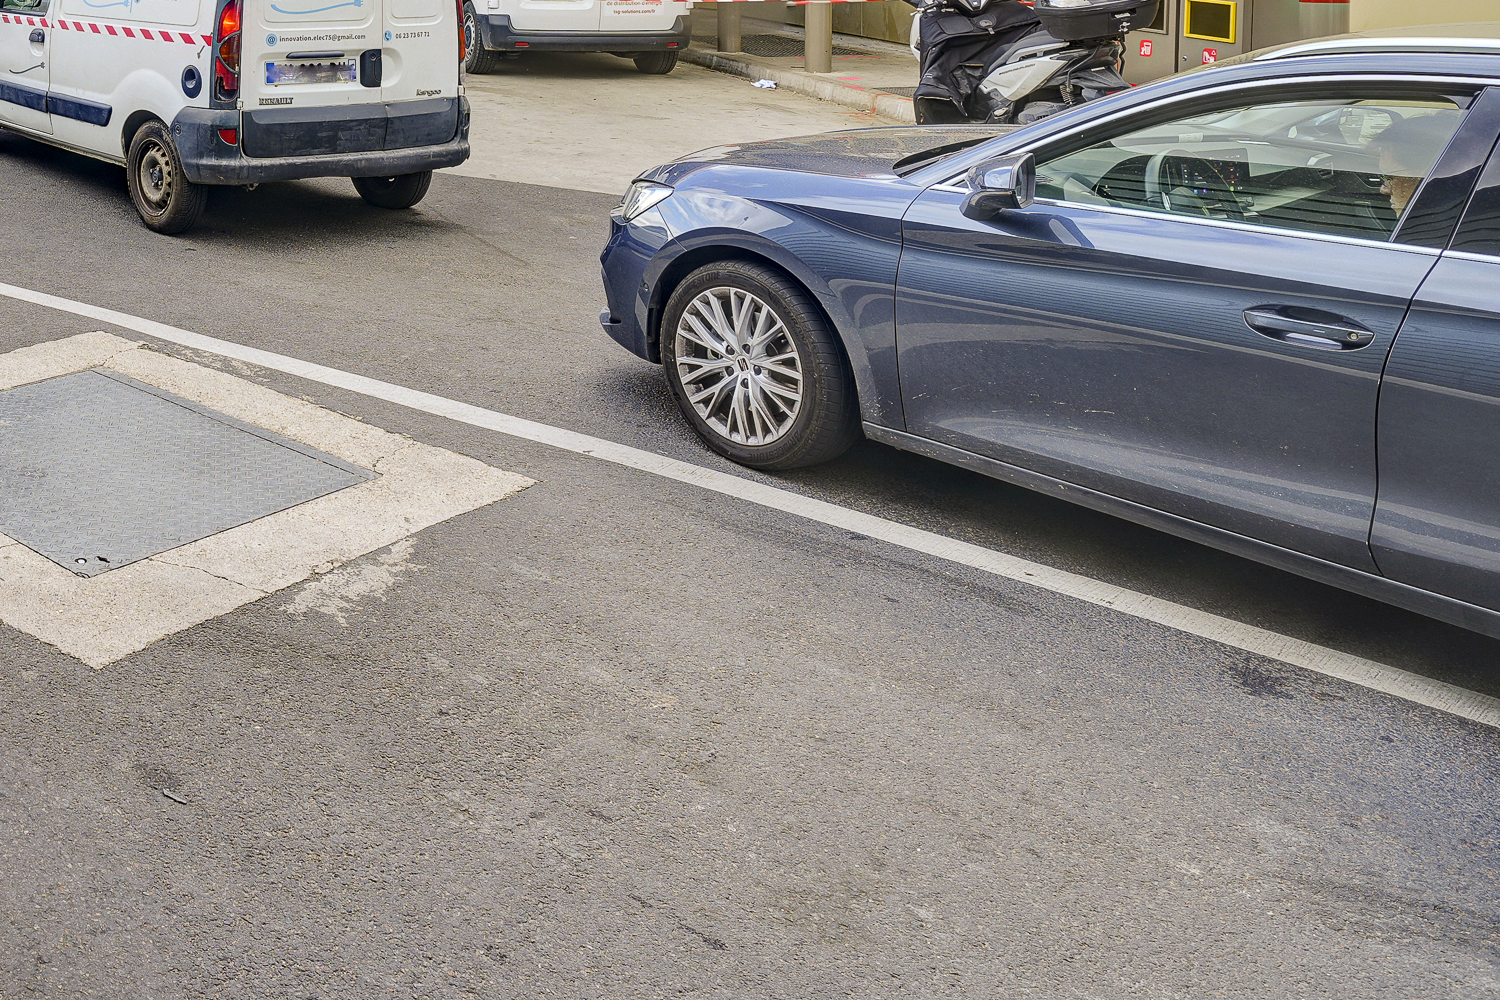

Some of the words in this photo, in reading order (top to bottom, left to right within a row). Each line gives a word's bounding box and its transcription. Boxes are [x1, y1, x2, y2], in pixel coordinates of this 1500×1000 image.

[279, 34, 366, 43] innovation.elec75@gmail.com
[416, 88, 442, 97] Kangoo
[259, 97, 293, 105] RENAULT
